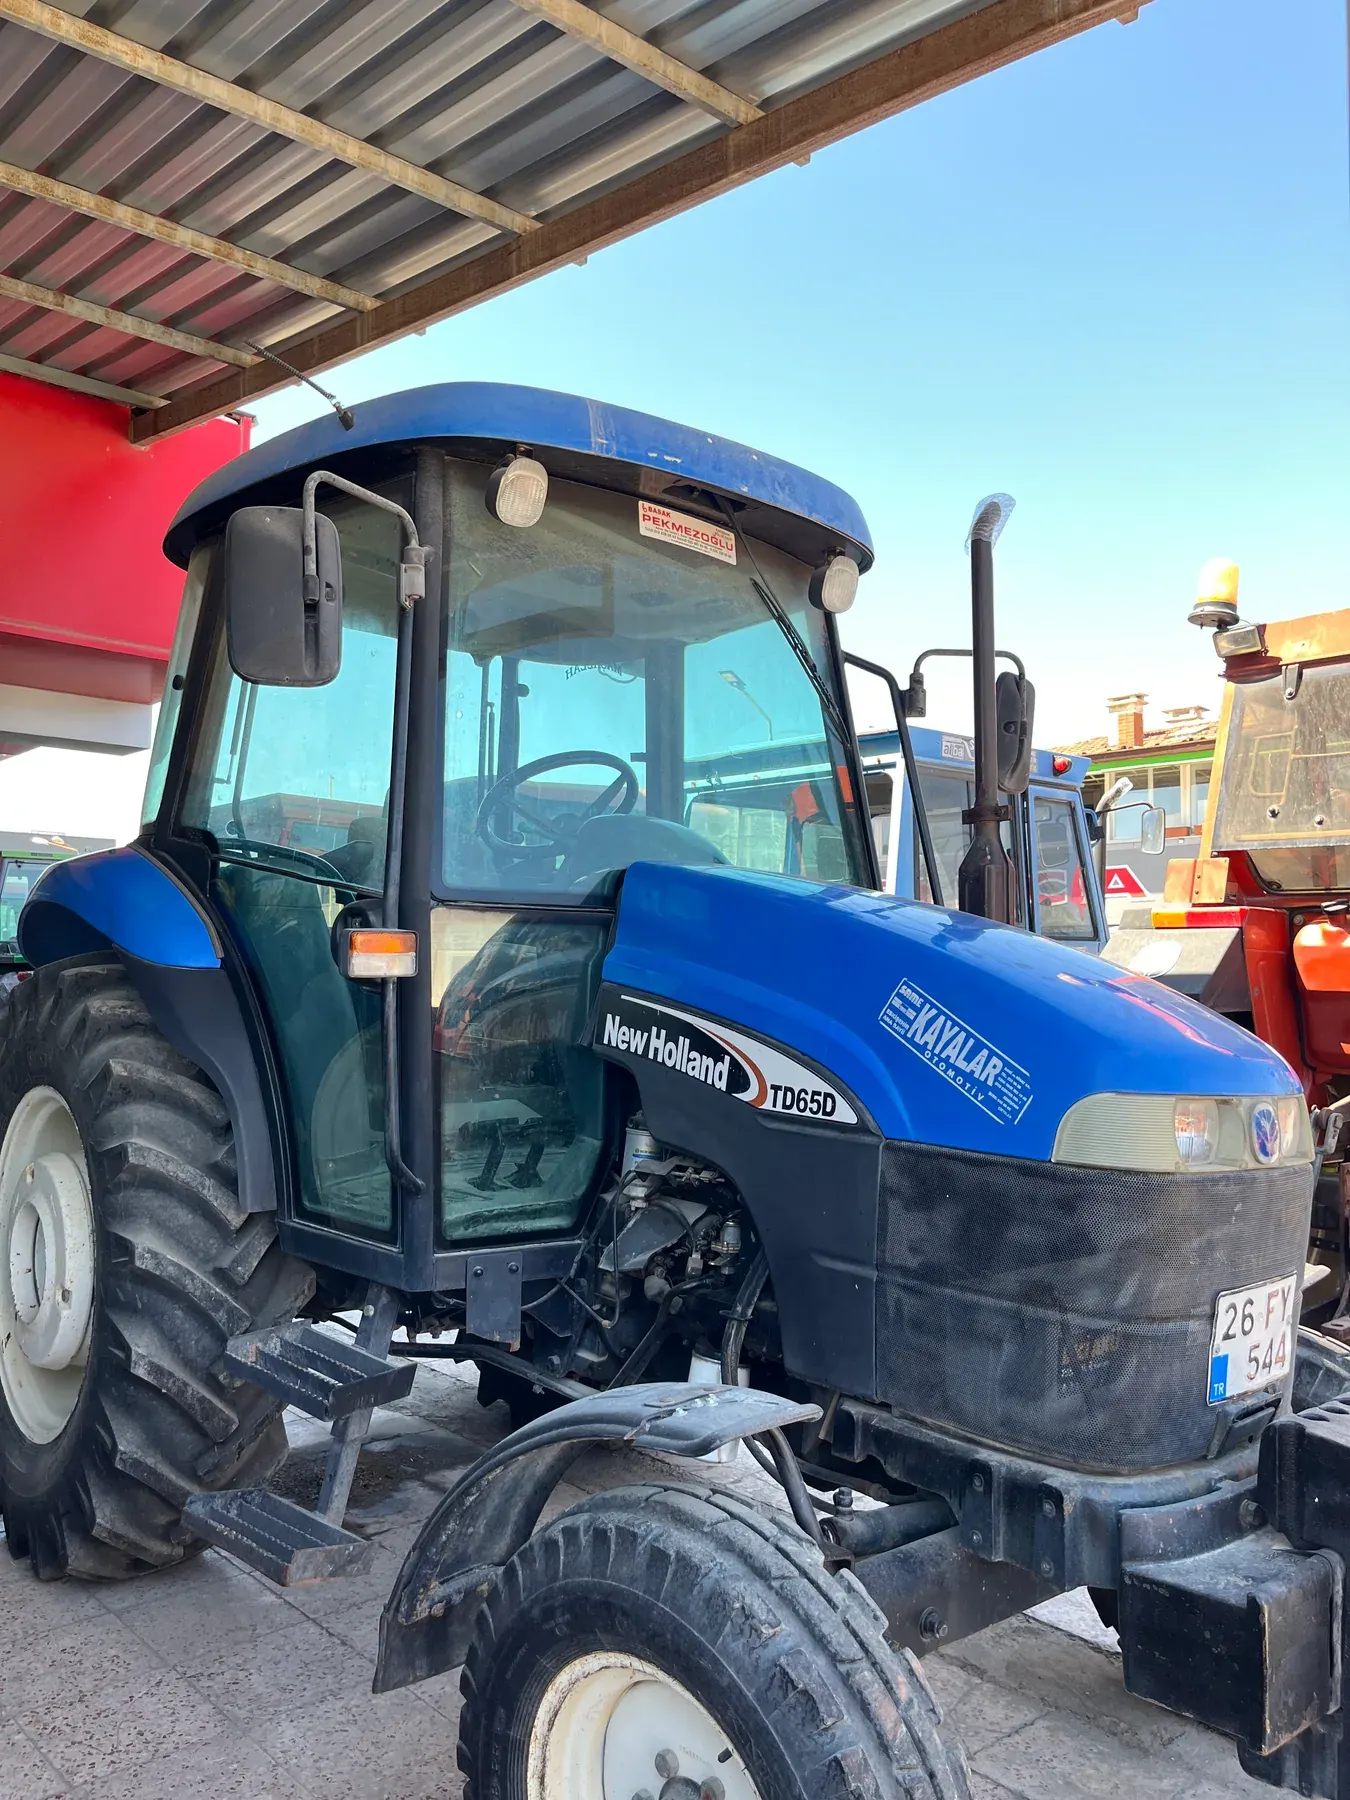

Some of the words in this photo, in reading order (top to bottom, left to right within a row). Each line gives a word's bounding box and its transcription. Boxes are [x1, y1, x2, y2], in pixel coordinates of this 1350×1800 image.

[943, 743, 964, 759] alba
[899, 985, 924, 1007] SAME
[603, 1013, 648, 1055] New
[648, 1025, 730, 1091] Holland
[907, 1003, 1003, 1087] KAYALAR
[924, 1051, 984, 1101] OTOMOTİV
[770, 1084, 836, 1117] TD65D
[1222, 1298, 1254, 1341] 26
[1265, 1285, 1291, 1330] FY
[1247, 1332, 1286, 1380] 544
[1213, 1382, 1224, 1396] TR
